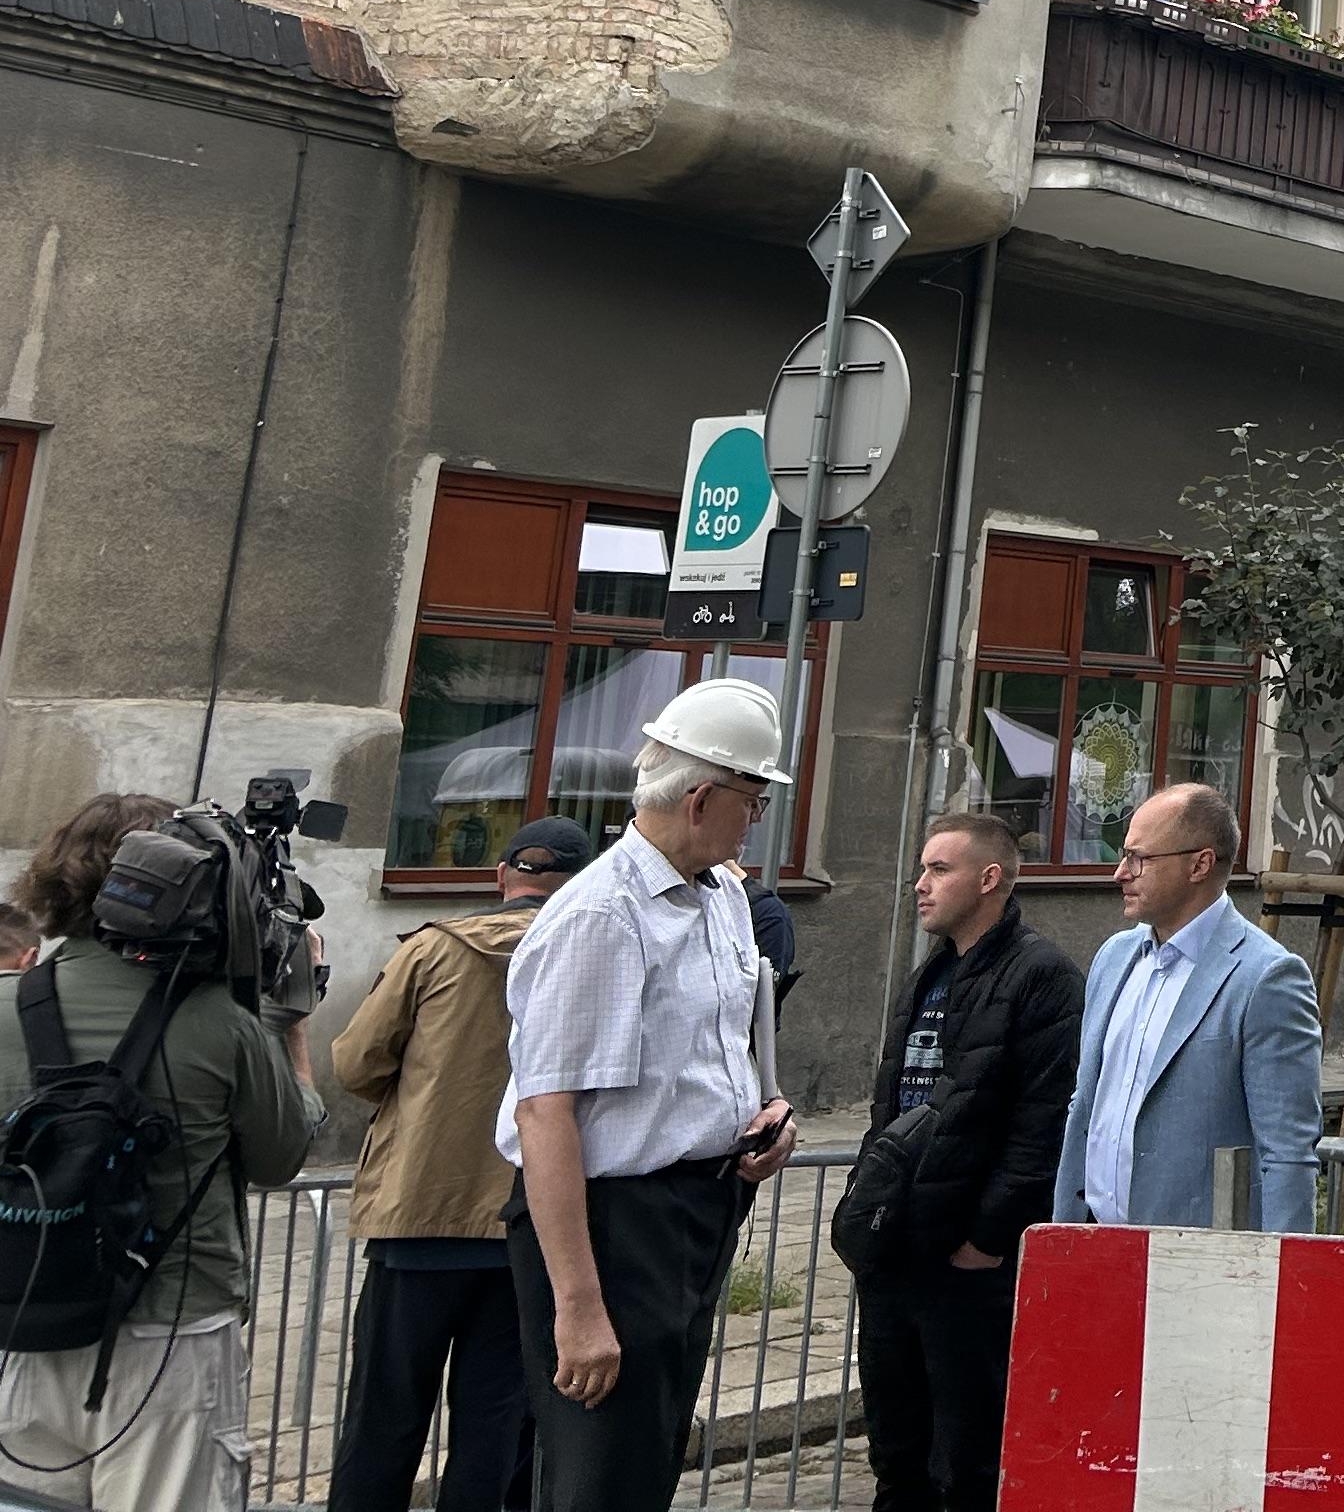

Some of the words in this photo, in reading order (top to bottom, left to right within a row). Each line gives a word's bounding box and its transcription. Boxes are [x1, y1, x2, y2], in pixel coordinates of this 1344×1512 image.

[699, 481, 739, 513] hop
[695, 509, 710, 536] &
[713, 514, 741, 541] go
